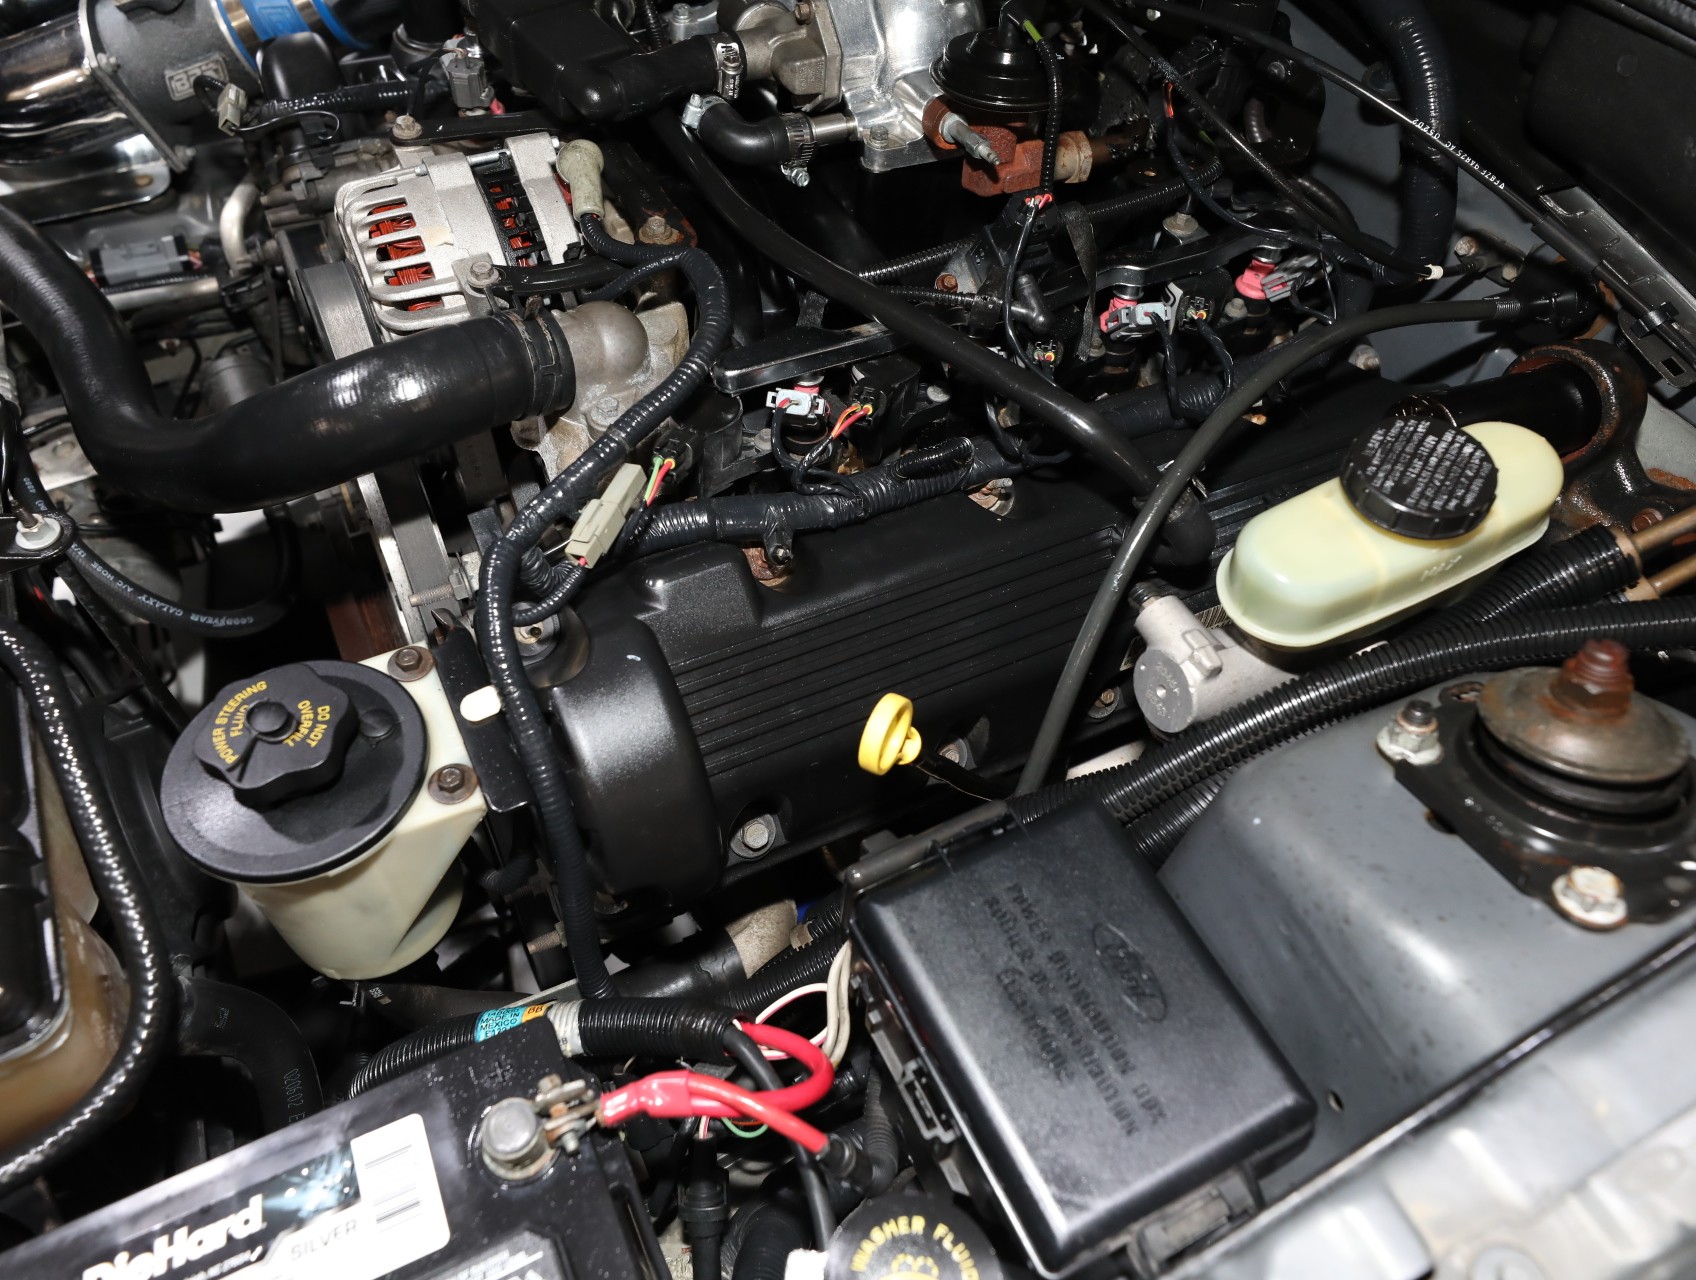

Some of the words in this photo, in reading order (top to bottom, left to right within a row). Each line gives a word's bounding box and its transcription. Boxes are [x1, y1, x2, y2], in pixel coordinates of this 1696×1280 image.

[91, 561, 115, 582] HOSE
[116, 580, 134, 593] A/C
[137, 593, 184, 617] GALAXY
[190, 612, 254, 627] GOODYEAR
[214, 680, 268, 725] STEERING
[317, 705, 330, 721] DO
[229, 704, 250, 738] FLUID
[282, 699, 314, 747] OVERFILL
[212, 726, 239, 764] POWER
[305, 723, 328, 748] NOT
[480, 1012, 506, 1025] MADE
[480, 1018, 518, 1031] MEXICO
[289, 1218, 358, 1263] SILVER
[851, 1214, 926, 1273] WASHER
[932, 1222, 980, 1280] FLUID
